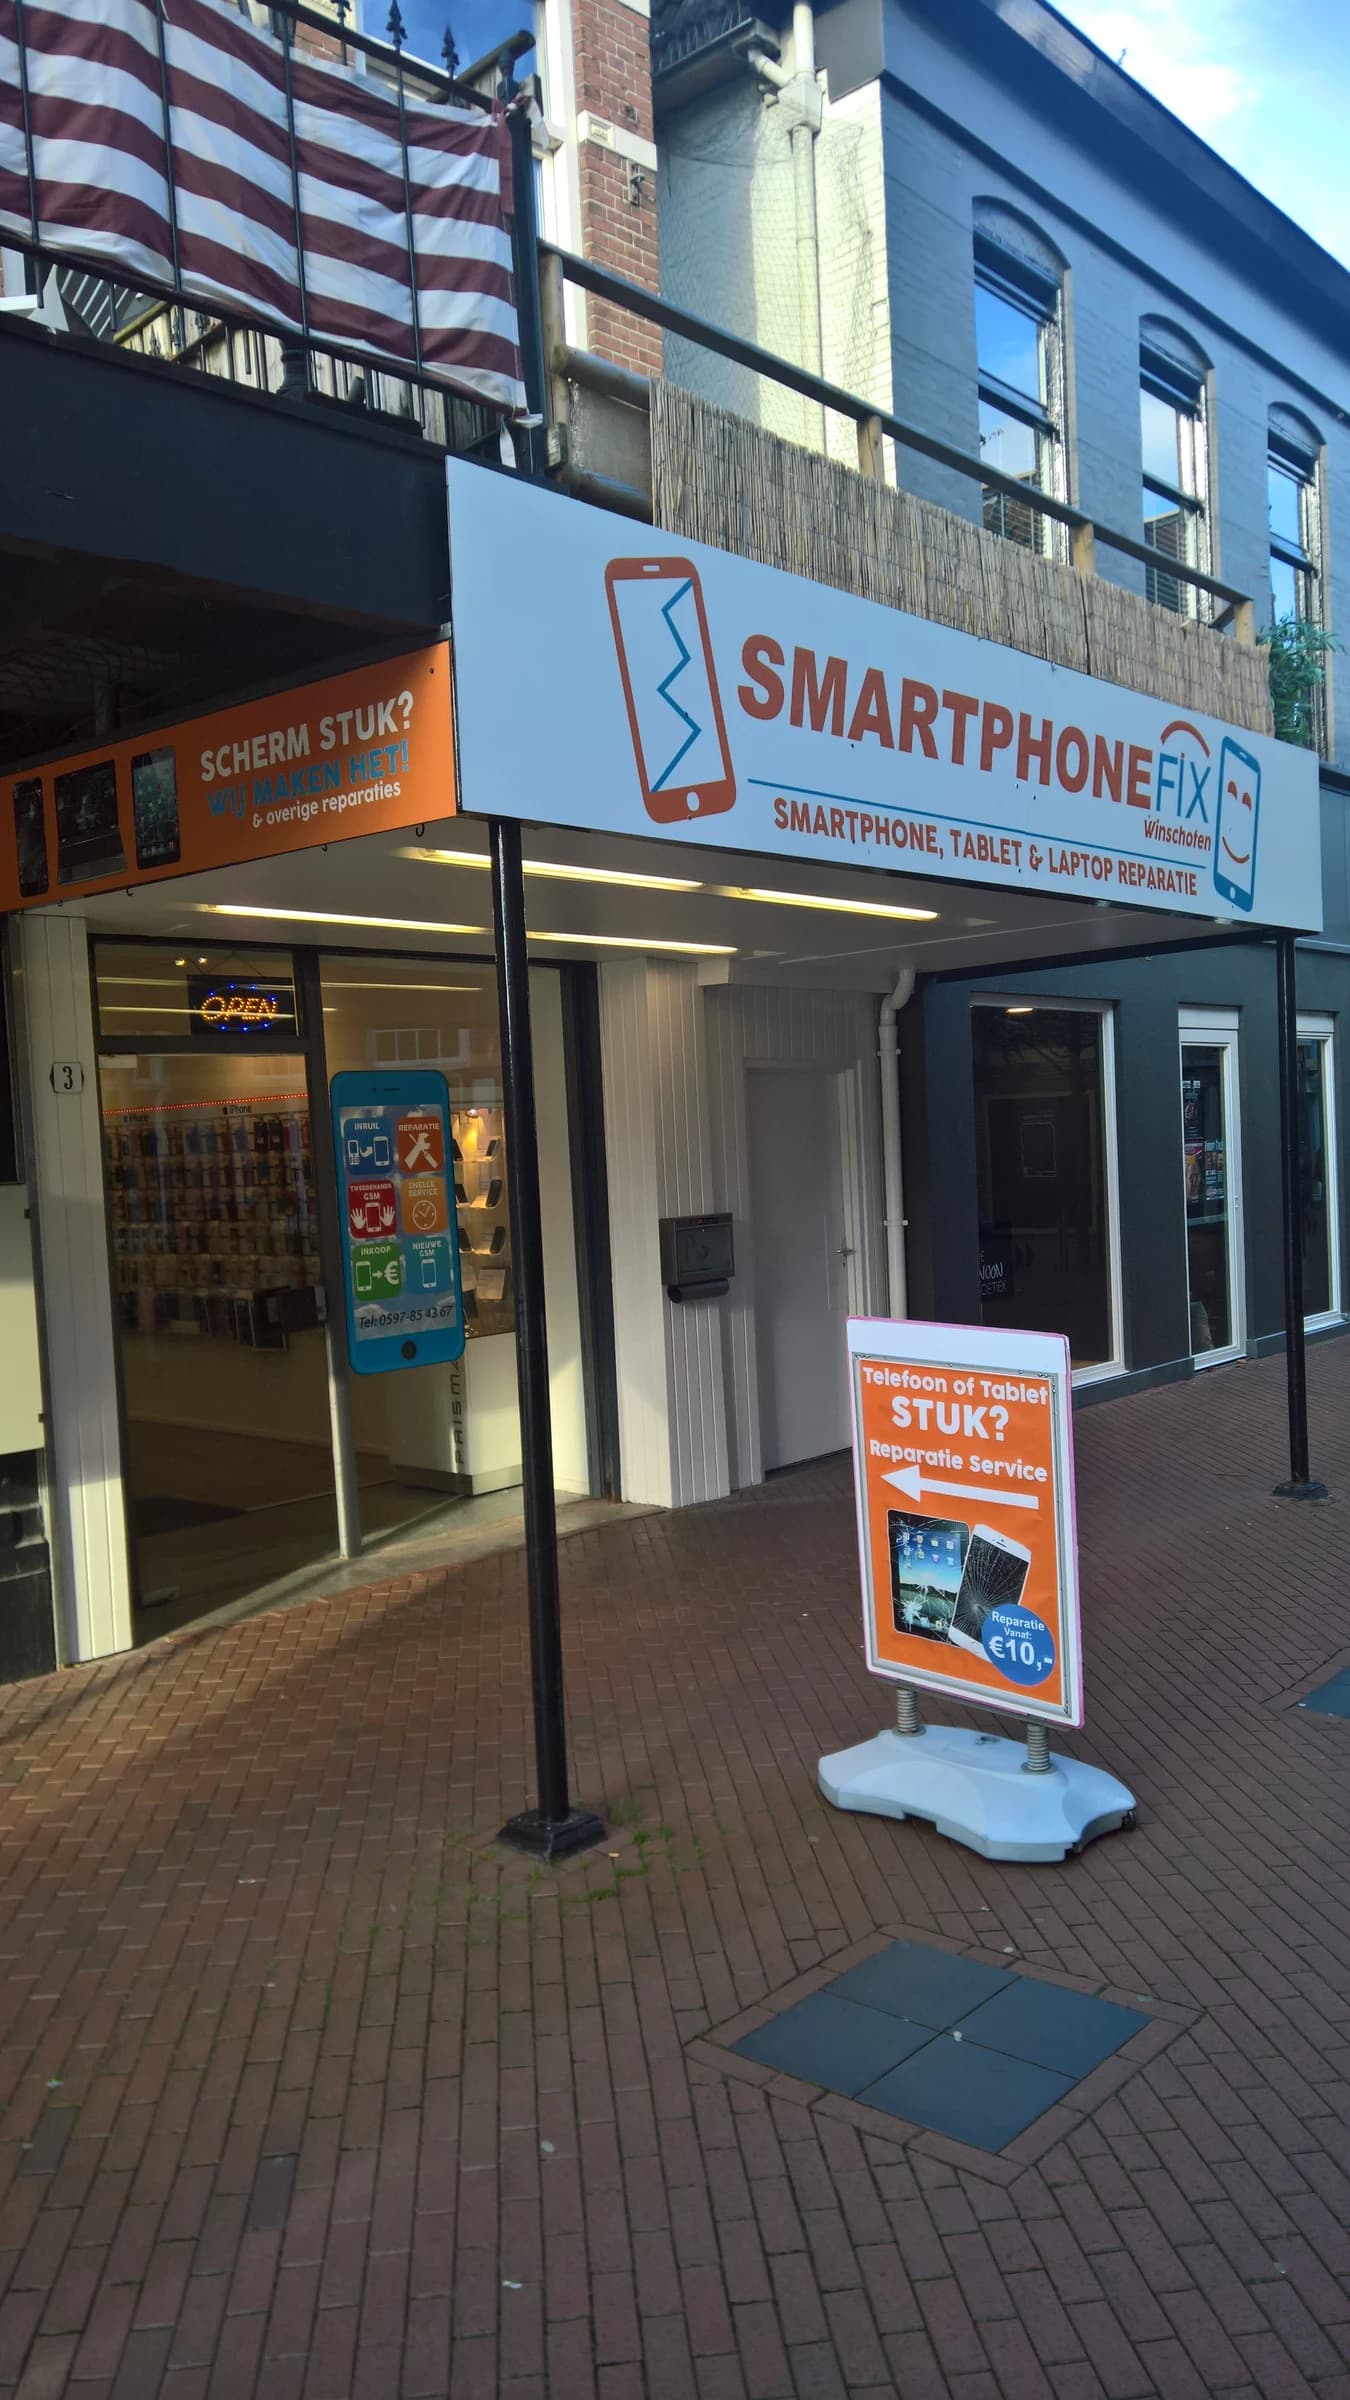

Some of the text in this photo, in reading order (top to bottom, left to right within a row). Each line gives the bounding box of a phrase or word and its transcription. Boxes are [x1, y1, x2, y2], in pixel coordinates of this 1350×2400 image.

[200, 690, 414, 782] SCHERM STUK?
[253, 758, 341, 806] MAKEN
[350, 738, 410, 785] HET!
[252, 780, 402, 829] & overige reparaties
[773, 797, 1199, 896] SMARTPHONE, TABLET & LAPTOP REPARATIE
[1143, 817, 1212, 852] Winschoten
[201, 995, 277, 1021] OPEN
[62, 1065, 73, 1090] 3
[354, 1121, 380, 1131] INRUIL
[398, 1122, 441, 1132] REPARATIE
[363, 1192, 381, 1201] GSM
[361, 1245, 391, 1256] INKOOP
[412, 1240, 442, 1250] NIEUWE
[419, 1249, 435, 1257] GSM
[863, 1366, 1049, 1406] Telefoon of Tablet
[891, 1395, 1010, 1442] STUK?
[869, 1439, 1048, 1483] Reparatie Service
[991, 1610, 1046, 1632] Reparatie
[1003, 1626, 1033, 1641] Vanaf:
[988, 1635, 1054, 1672] €10,-
